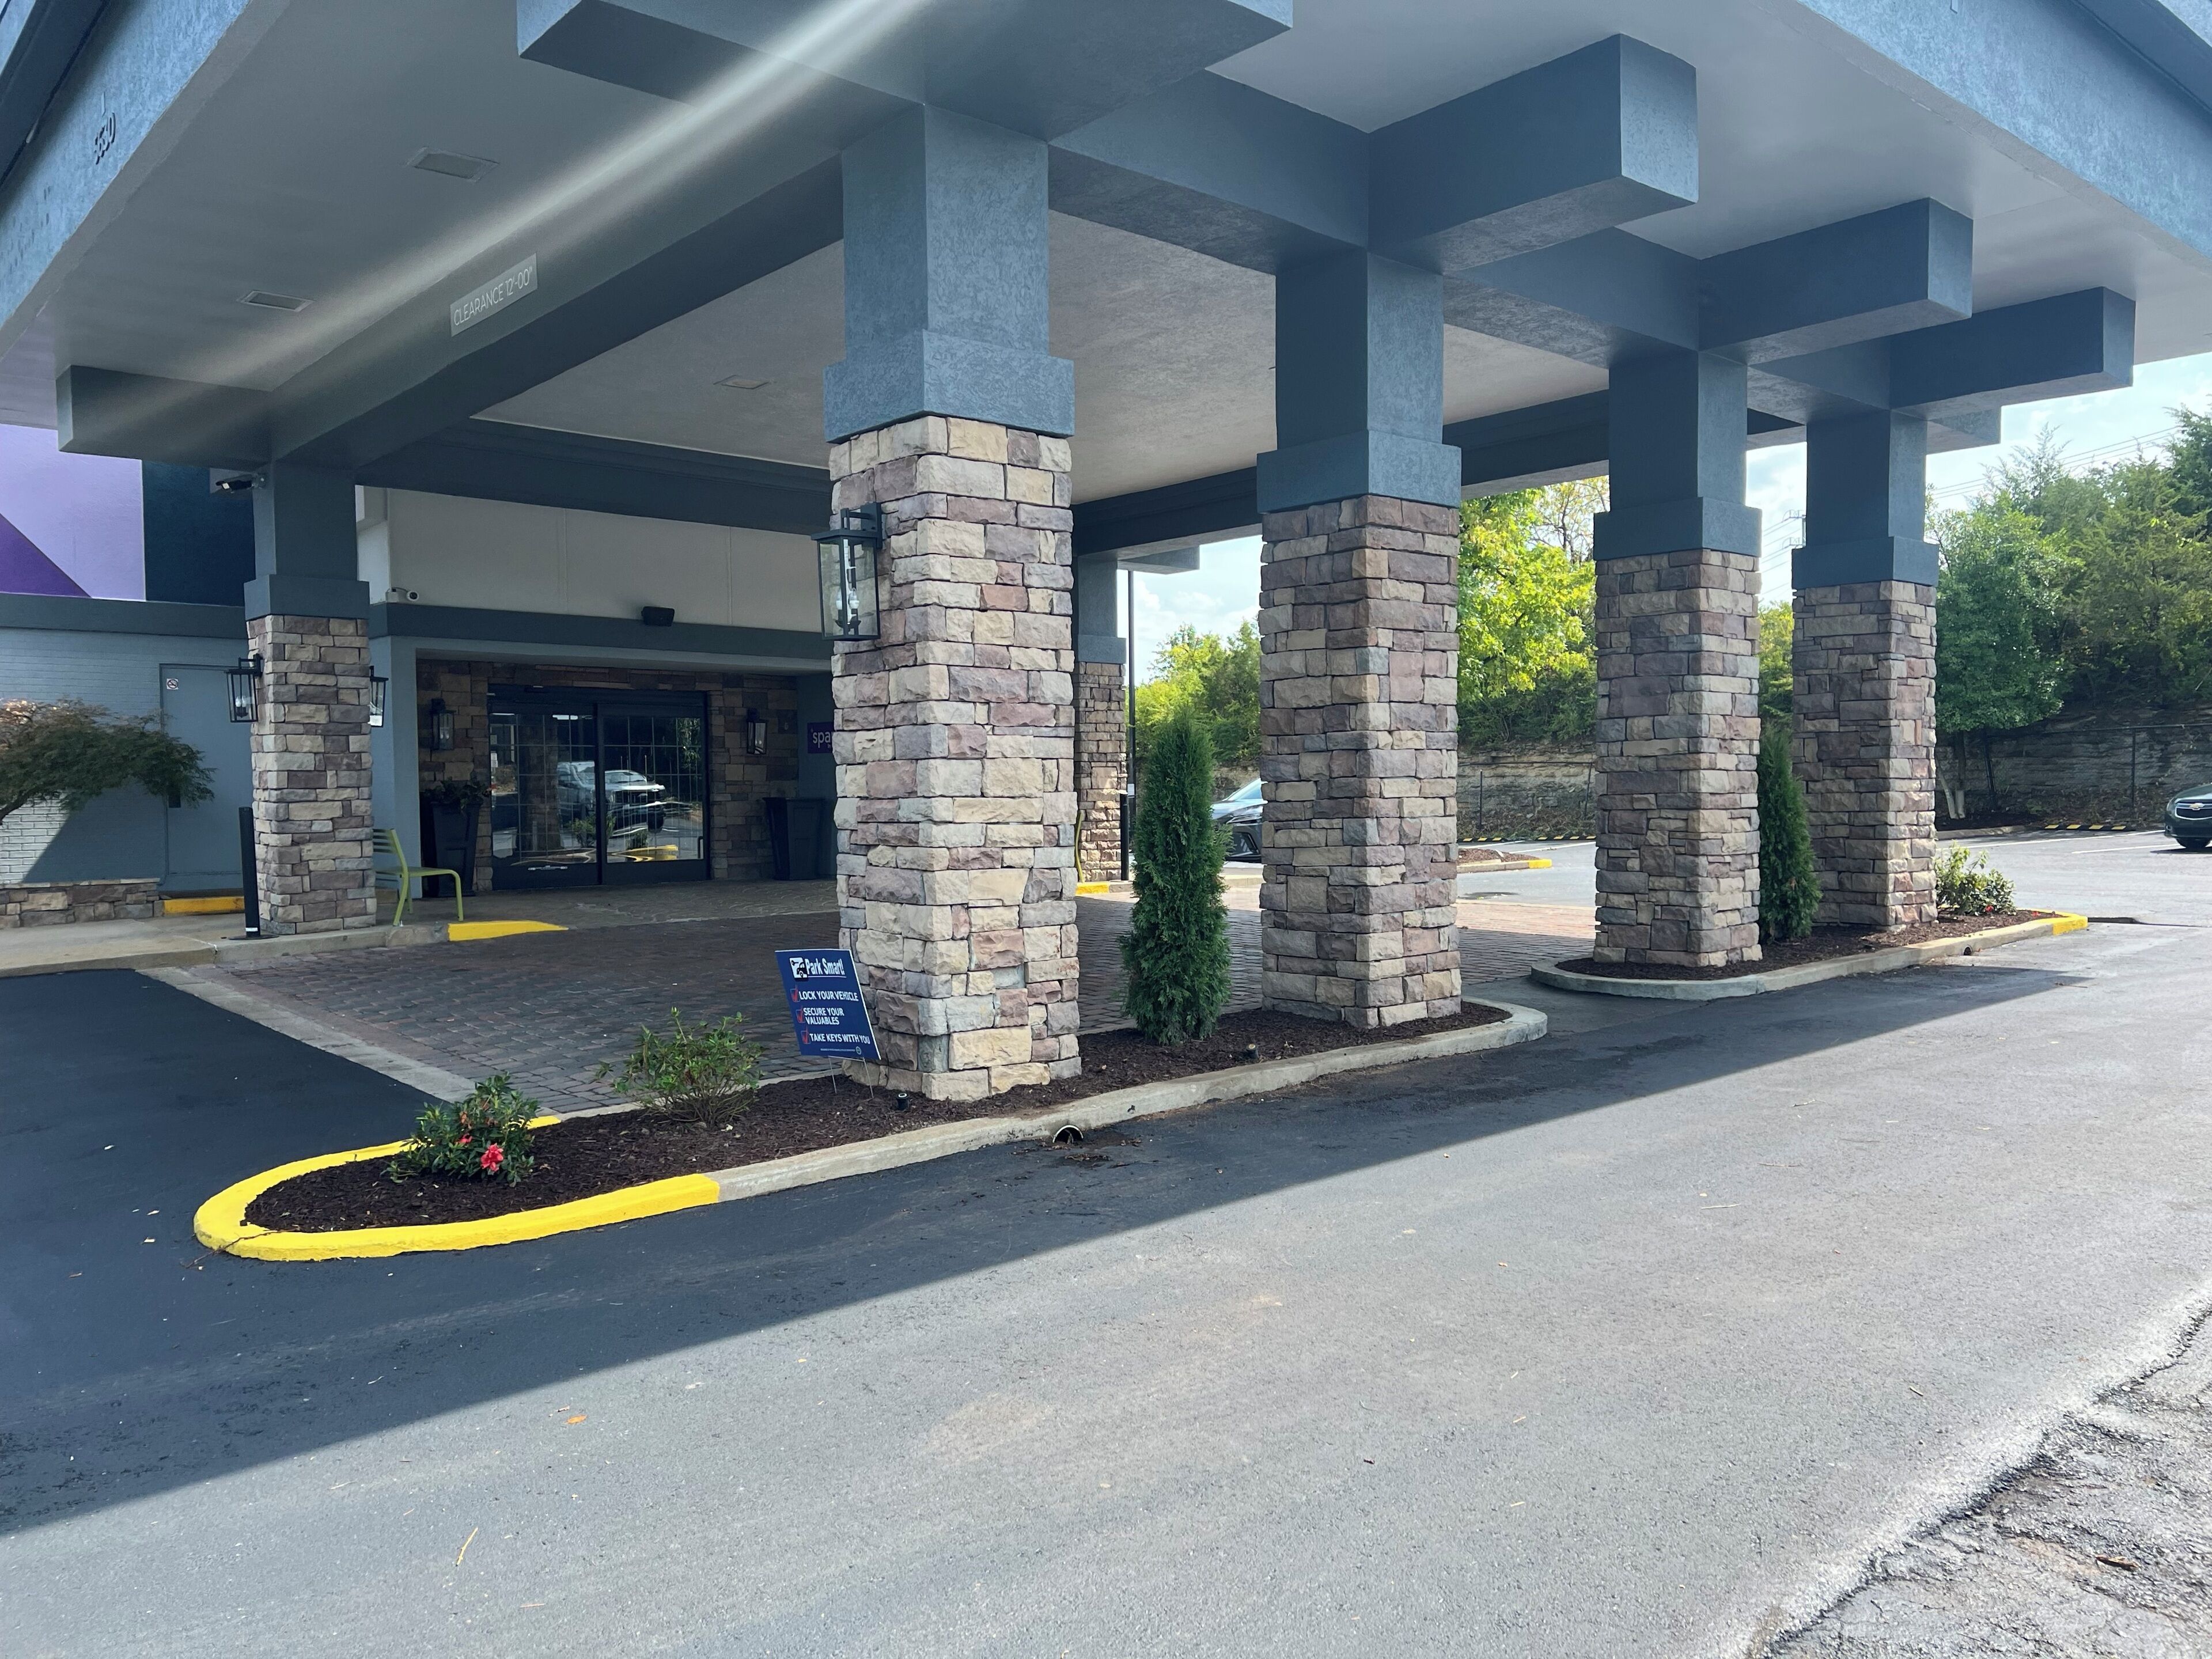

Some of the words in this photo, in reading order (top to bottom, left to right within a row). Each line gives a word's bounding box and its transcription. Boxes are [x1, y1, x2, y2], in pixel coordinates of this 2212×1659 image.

[454, 283, 504, 326] CLEARANCE
[812, 731, 833, 748] spa
[805, 958, 823, 975] Park
[822, 958, 845, 975] Smart!
[798, 990, 817, 1000] LOCK
[816, 990, 836, 1000] YOUR
[834, 990, 859, 1001] VEHICLE
[803, 1007, 827, 1016] SECURE
[826, 1007, 844, 1016] YOUR
[805, 1016, 839, 1025] VALUABLES
[809, 1033, 826, 1041] TAKE
[826, 1033, 842, 1042] KEYS
[841, 1033, 860, 1043] WITH
[858, 1035, 870, 1044] YOU
